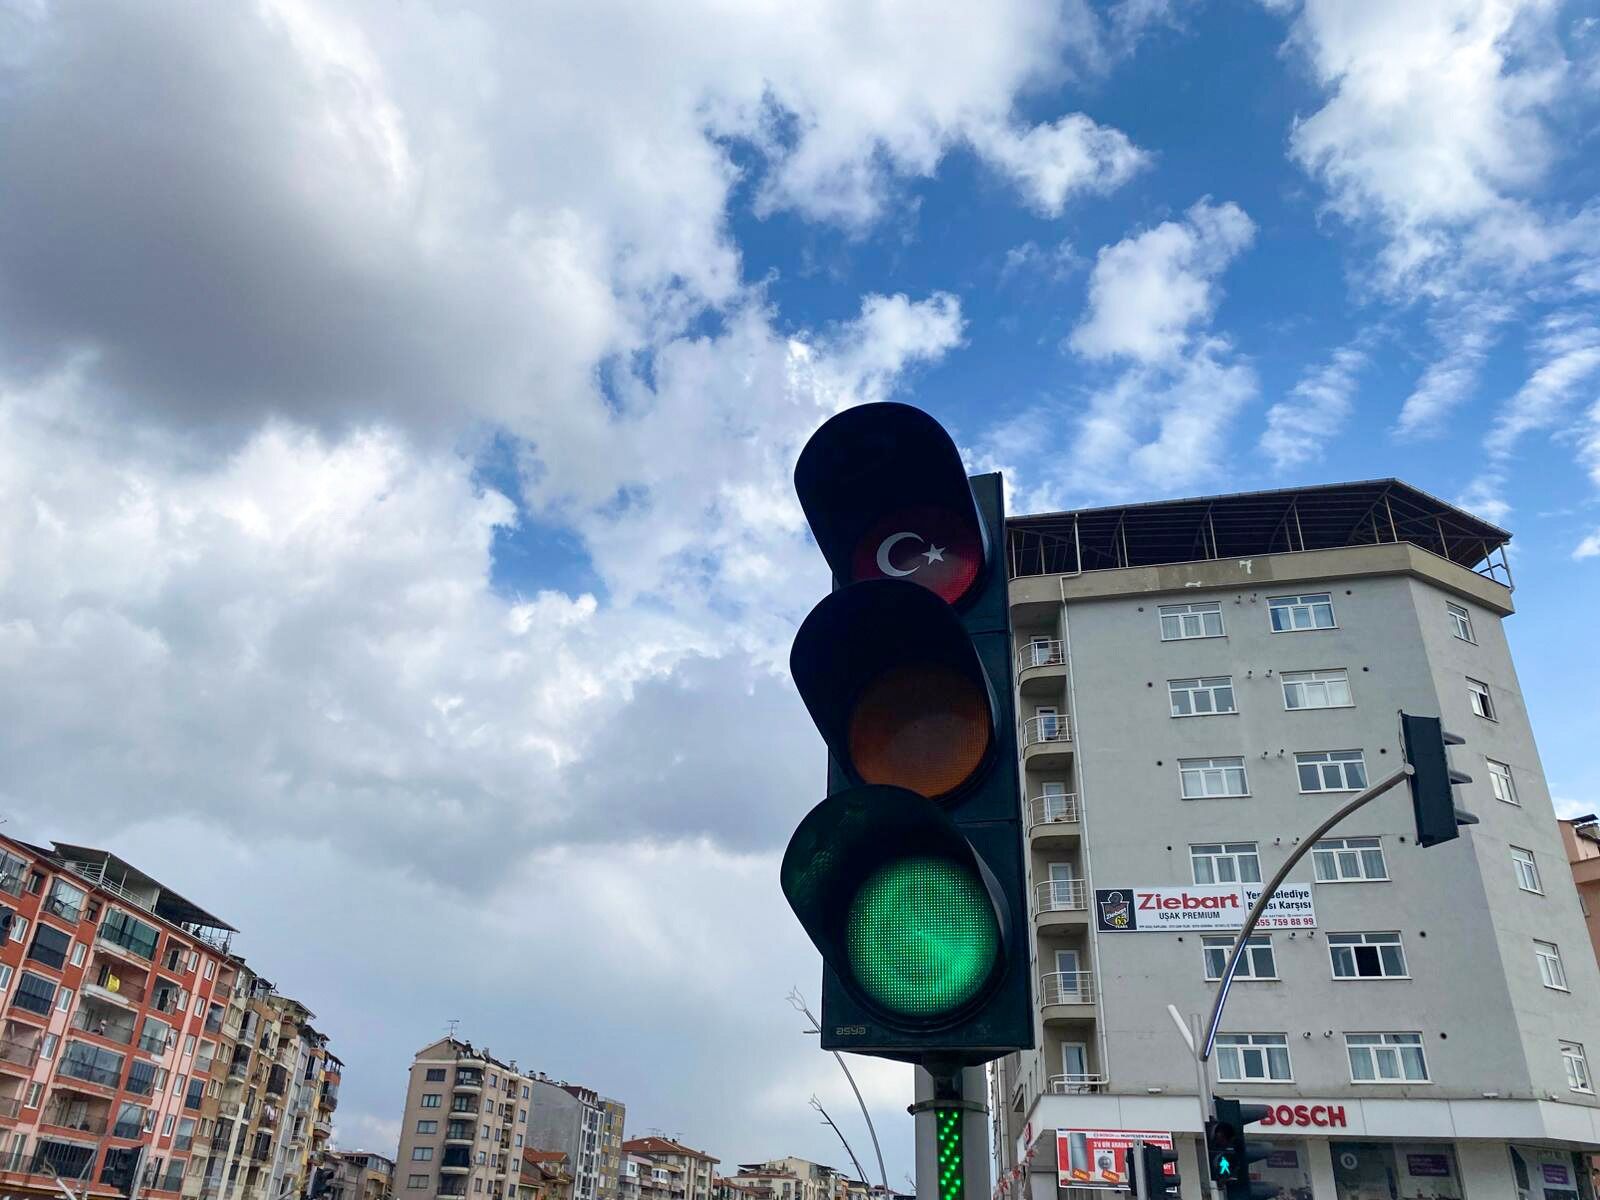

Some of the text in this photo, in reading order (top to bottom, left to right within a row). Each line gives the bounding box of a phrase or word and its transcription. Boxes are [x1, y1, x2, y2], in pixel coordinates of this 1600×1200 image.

[1137, 893, 1240, 910] Ziebart
[1279, 901, 1312, 911] Karşısı
[1159, 911, 1220, 921] UŞAK PREMIUM
[1272, 918, 1288, 926] 759
[1290, 918, 1301, 926] 88
[1303, 917, 1314, 925] 99
